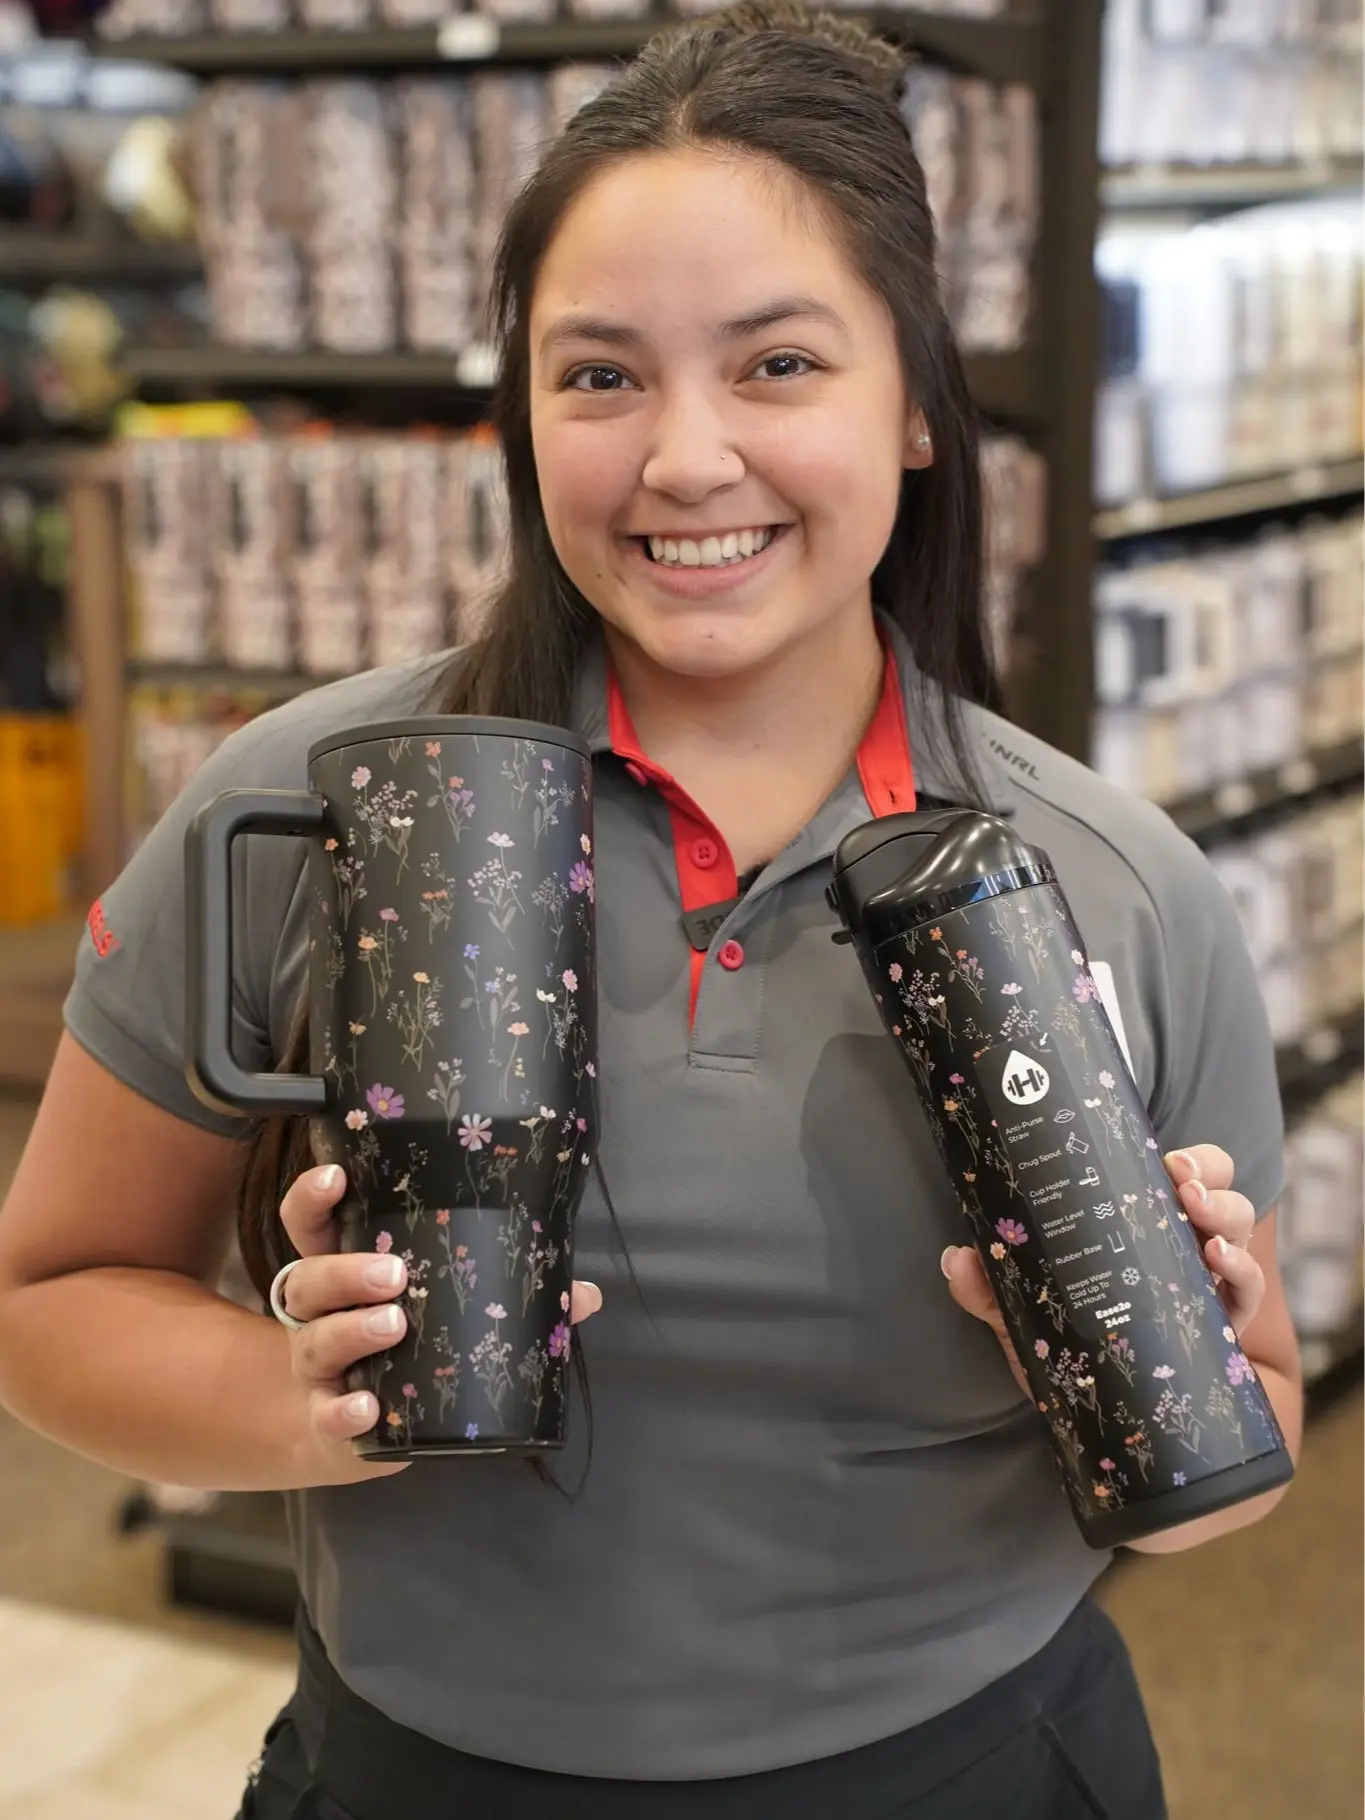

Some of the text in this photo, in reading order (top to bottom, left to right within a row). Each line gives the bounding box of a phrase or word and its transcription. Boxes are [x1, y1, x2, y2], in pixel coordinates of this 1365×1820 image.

[1005, 1117, 1044, 1135] Anti-Purse
[1008, 1131, 1029, 1144] Straw
[1018, 1149, 1062, 1170] Chug Spout
[1029, 1179, 1070, 1198] Cup Holder
[1032, 1192, 1062, 1206] Friendly
[1041, 1209, 1085, 1230] Water Level
[1044, 1223, 1076, 1238] Window
[1055, 1244, 1102, 1265] Rubber Base
[1065, 1270, 1112, 1292] Keeps Water
[1069, 1281, 1110, 1300] Cold Up To
[1072, 1292, 1106, 1310] 24 Hours
[1104, 1314, 1131, 1329] 24oz
